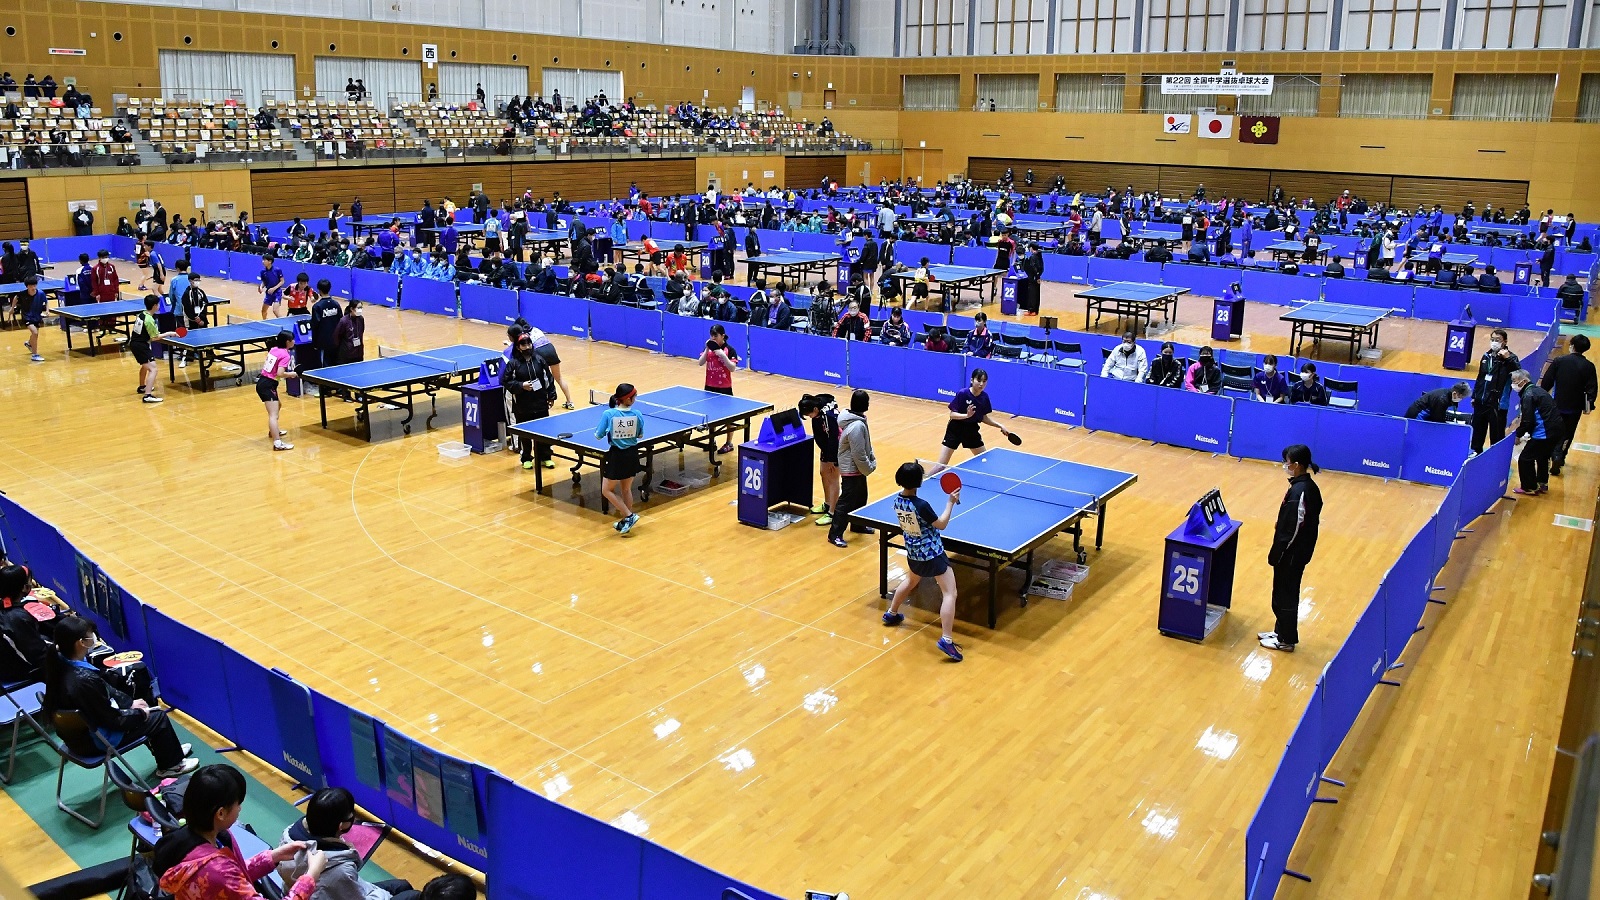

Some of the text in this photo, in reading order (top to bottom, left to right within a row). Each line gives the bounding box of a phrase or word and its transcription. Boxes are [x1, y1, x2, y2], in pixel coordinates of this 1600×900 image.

[425, 47, 434, 58] 西
[1166, 76, 1191, 85] 第22回
[702, 256, 709, 265] 20
[1357, 257, 1364, 265] 10
[840, 269, 848, 280] 21
[1519, 270, 1525, 279] 9
[1004, 287, 1014, 298] 22
[1217, 310, 1228, 321] 23
[1450, 336, 1464, 349] 24
[465, 401, 478, 422] 27
[1195, 434, 1219, 445] Nittaku
[1362, 458, 1389, 469] Nittaku
[1424, 465, 1453, 477] Nittaku
[744, 466, 761, 490] 26
[1172, 565, 1199, 594] 25
[283, 750, 312, 775] Nittaku
